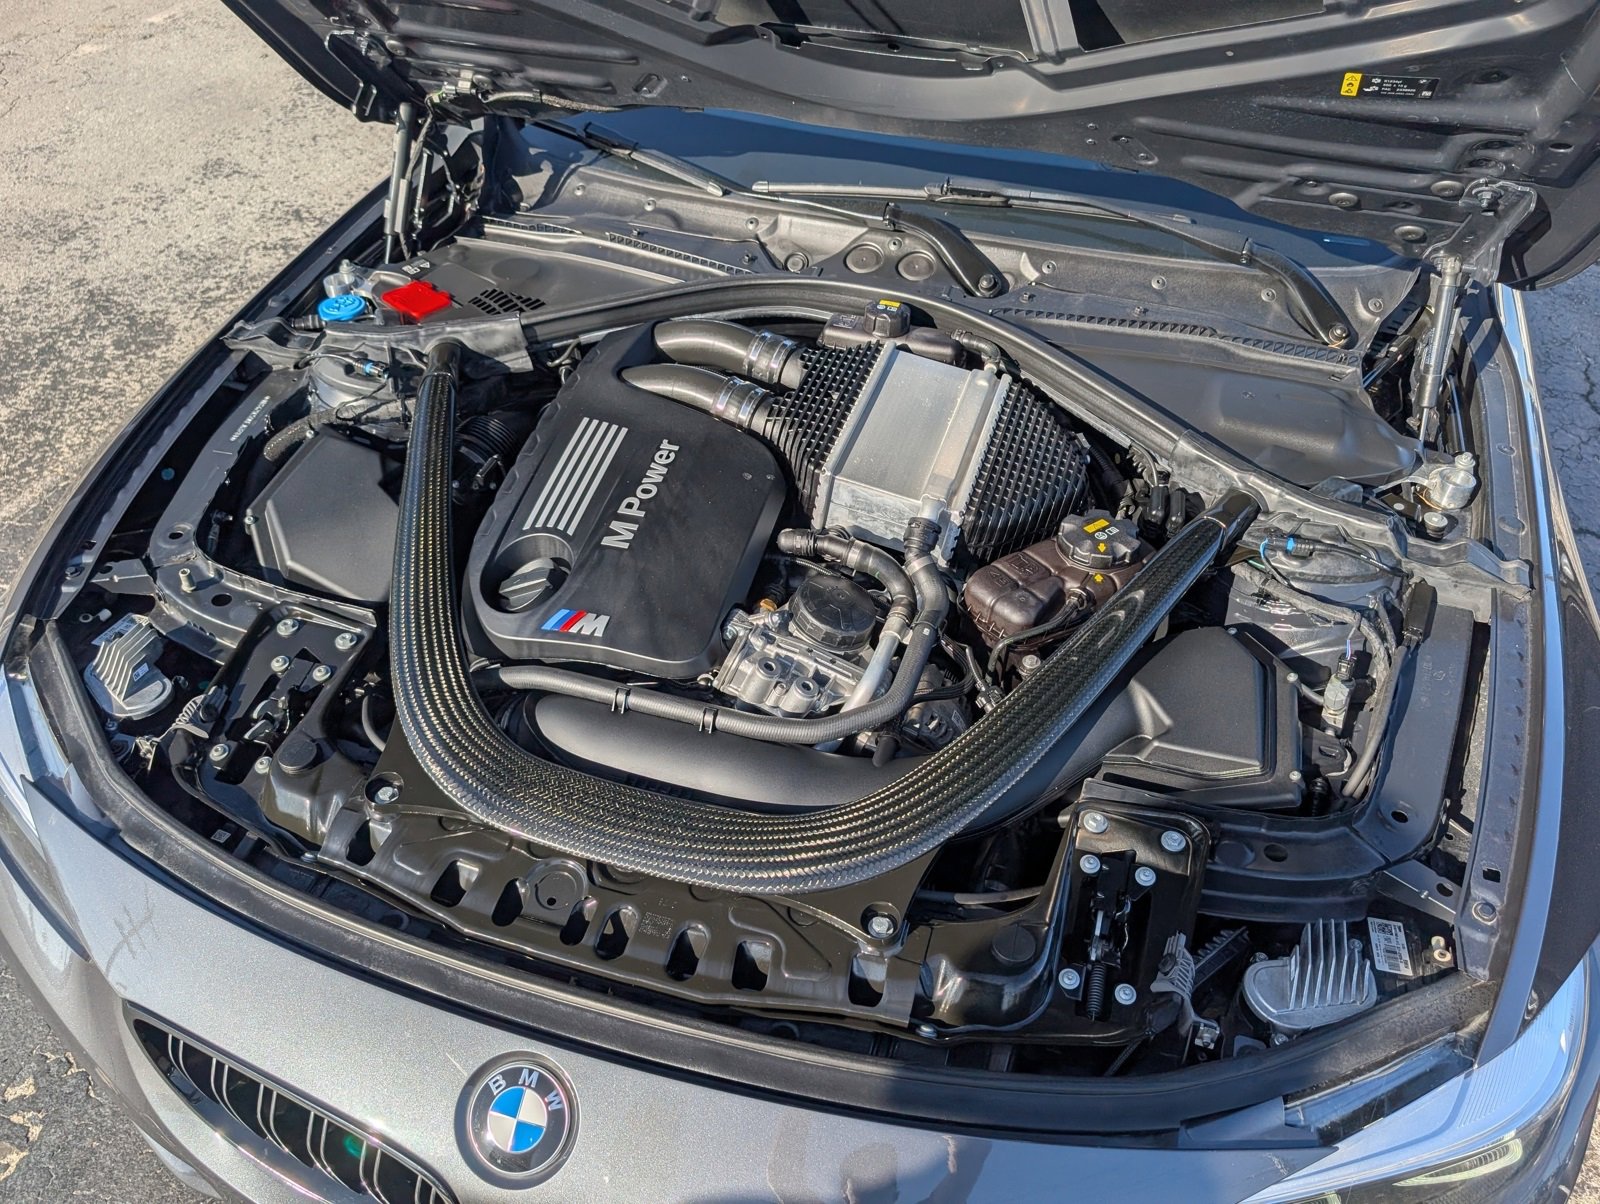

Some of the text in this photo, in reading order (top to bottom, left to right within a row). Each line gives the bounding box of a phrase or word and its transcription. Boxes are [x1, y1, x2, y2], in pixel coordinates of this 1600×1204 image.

[600, 439, 680, 549] M Power
[568, 612, 611, 637] M
[488, 1068, 563, 1111] BMW
